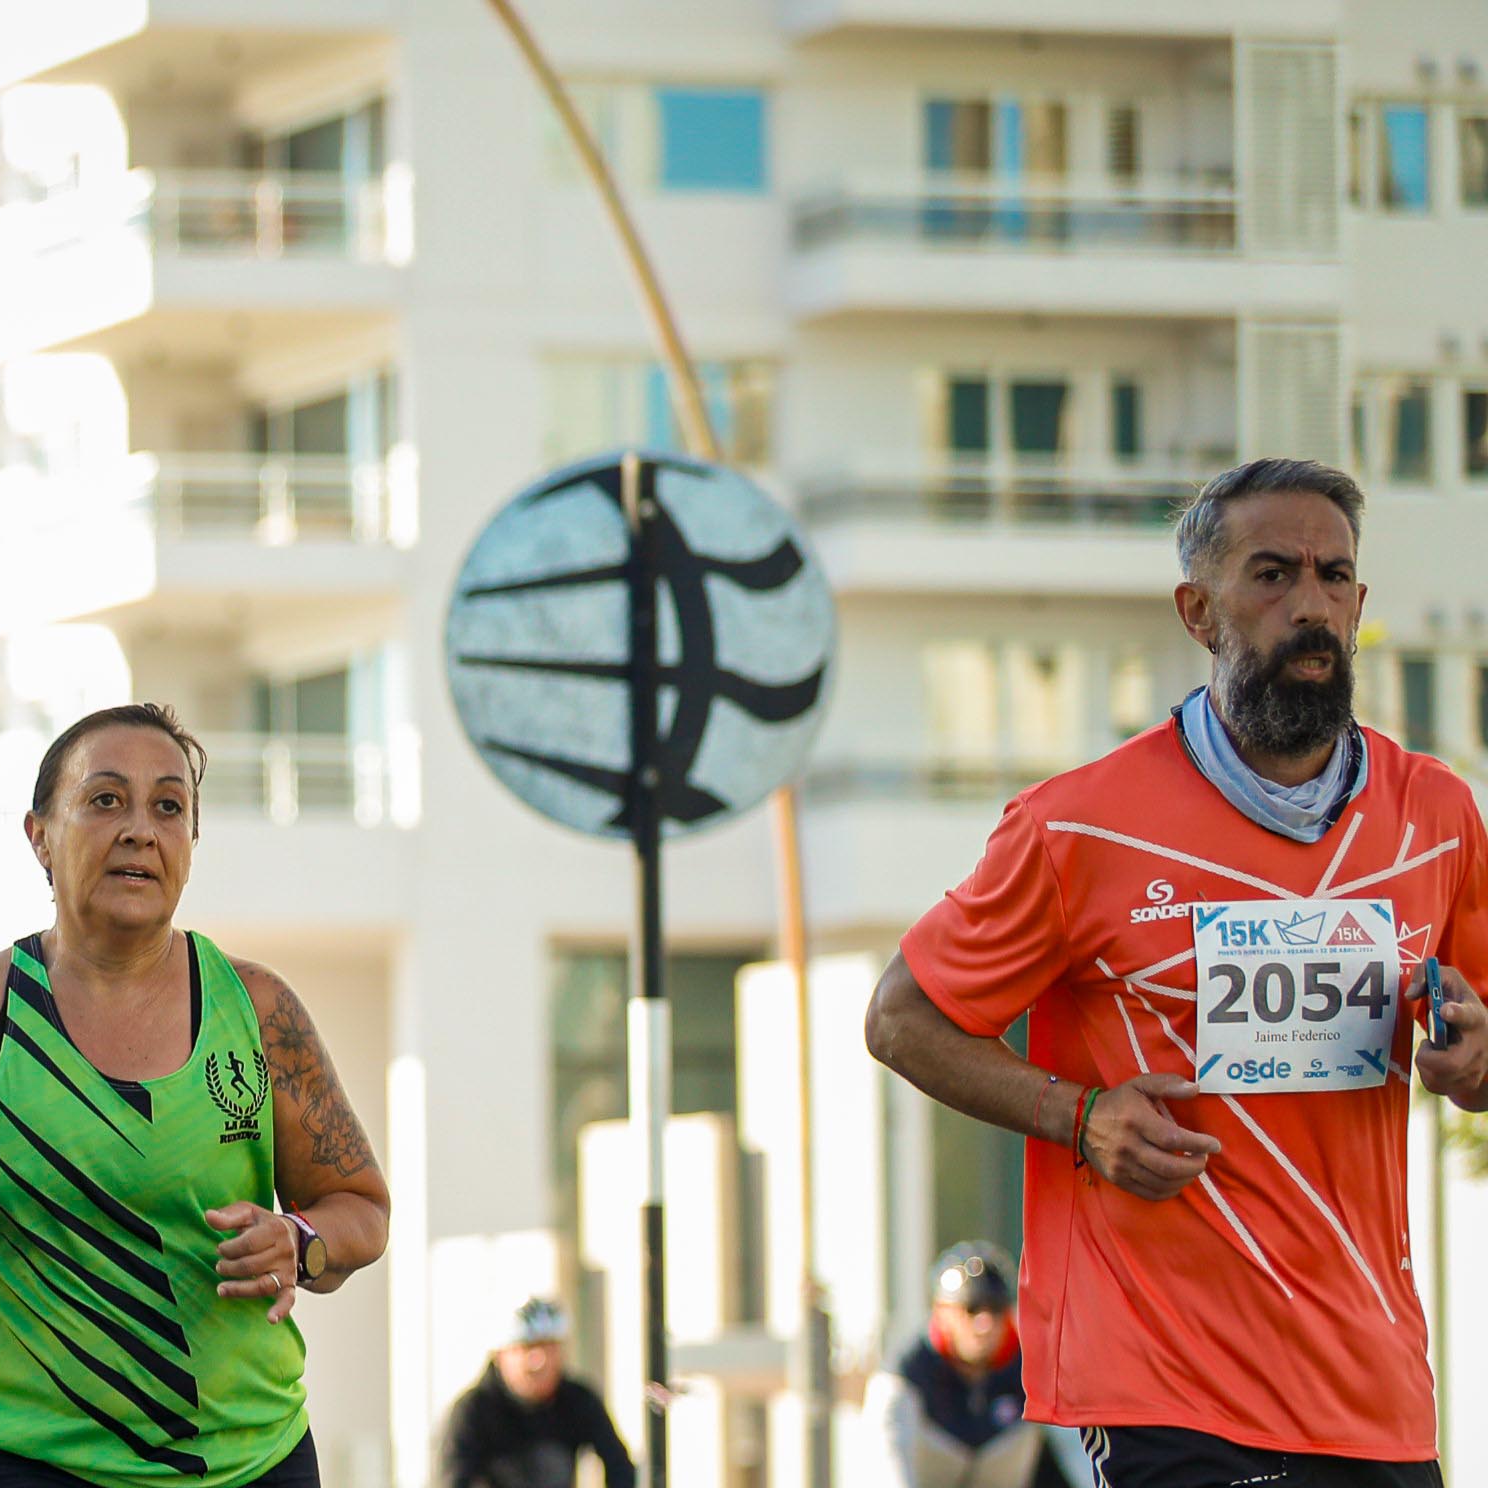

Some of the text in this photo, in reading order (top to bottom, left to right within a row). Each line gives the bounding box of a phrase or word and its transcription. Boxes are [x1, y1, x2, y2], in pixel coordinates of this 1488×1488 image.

[1216, 919, 1271, 947] 15K
[1336, 927, 1364, 942] 15K
[1207, 961, 1391, 1024] 2054
[1254, 1029, 1341, 1043] Jaime Federico
[1227, 1056, 1291, 1080] osde
